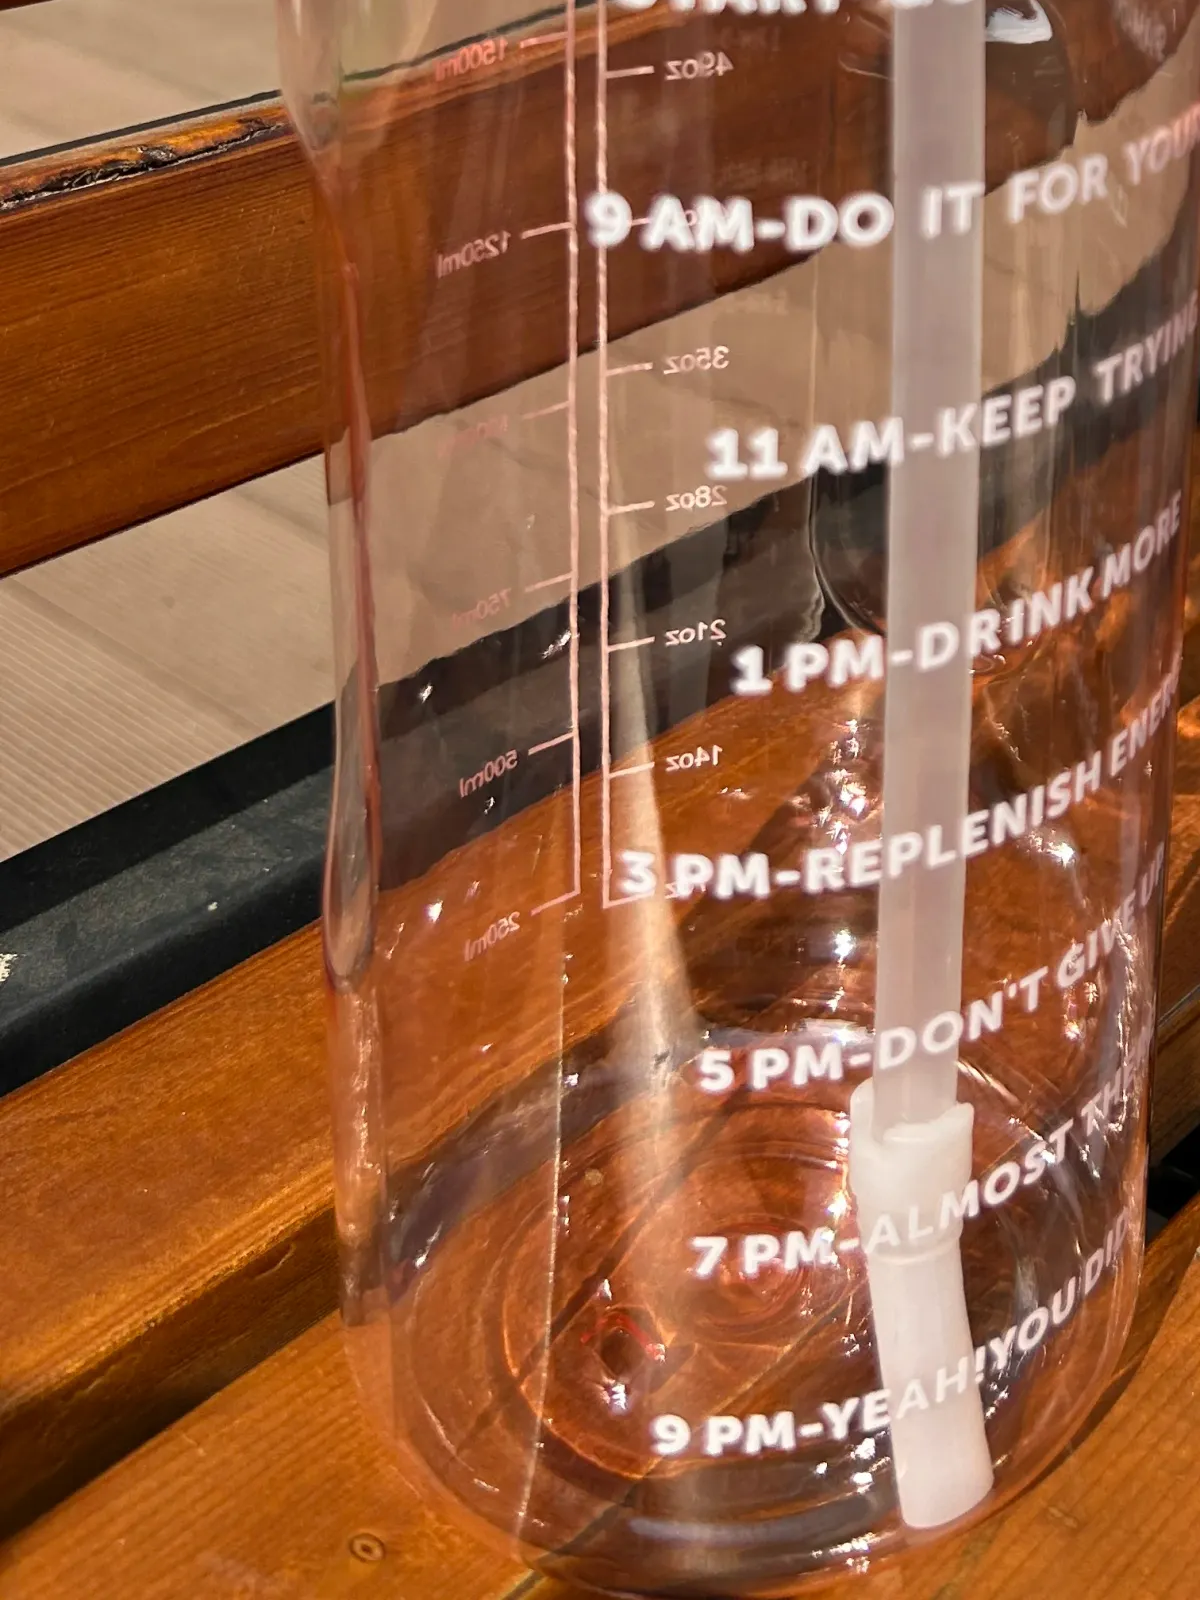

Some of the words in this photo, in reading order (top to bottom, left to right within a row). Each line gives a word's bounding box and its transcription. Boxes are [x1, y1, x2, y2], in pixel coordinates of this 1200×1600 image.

[582, 189, 633, 249] 9
[640, 193, 896, 254] AM-DO
[920, 180, 987, 241] IT
[1006, 152, 1109, 226] FOR
[706, 426, 789, 481] 11
[801, 374, 1077, 477] AM-KEEP
[731, 644, 773, 697] 1
[783, 564, 1096, 693] PM-DRINK
[1101, 489, 1182, 601] MORE
[617, 849, 659, 897] 3
[671, 750, 1103, 900] PM-REPLENISH
[699, 1049, 735, 1093] 5
[747, 964, 1049, 1088] PM-DON'T
[1056, 889, 1137, 990] GIVE
[689, 1235, 731, 1278] 7
[743, 1118, 1075, 1275] PM-ALMOST
[651, 1414, 692, 1456] 9
[1084, 1206, 1129, 1296] DID
